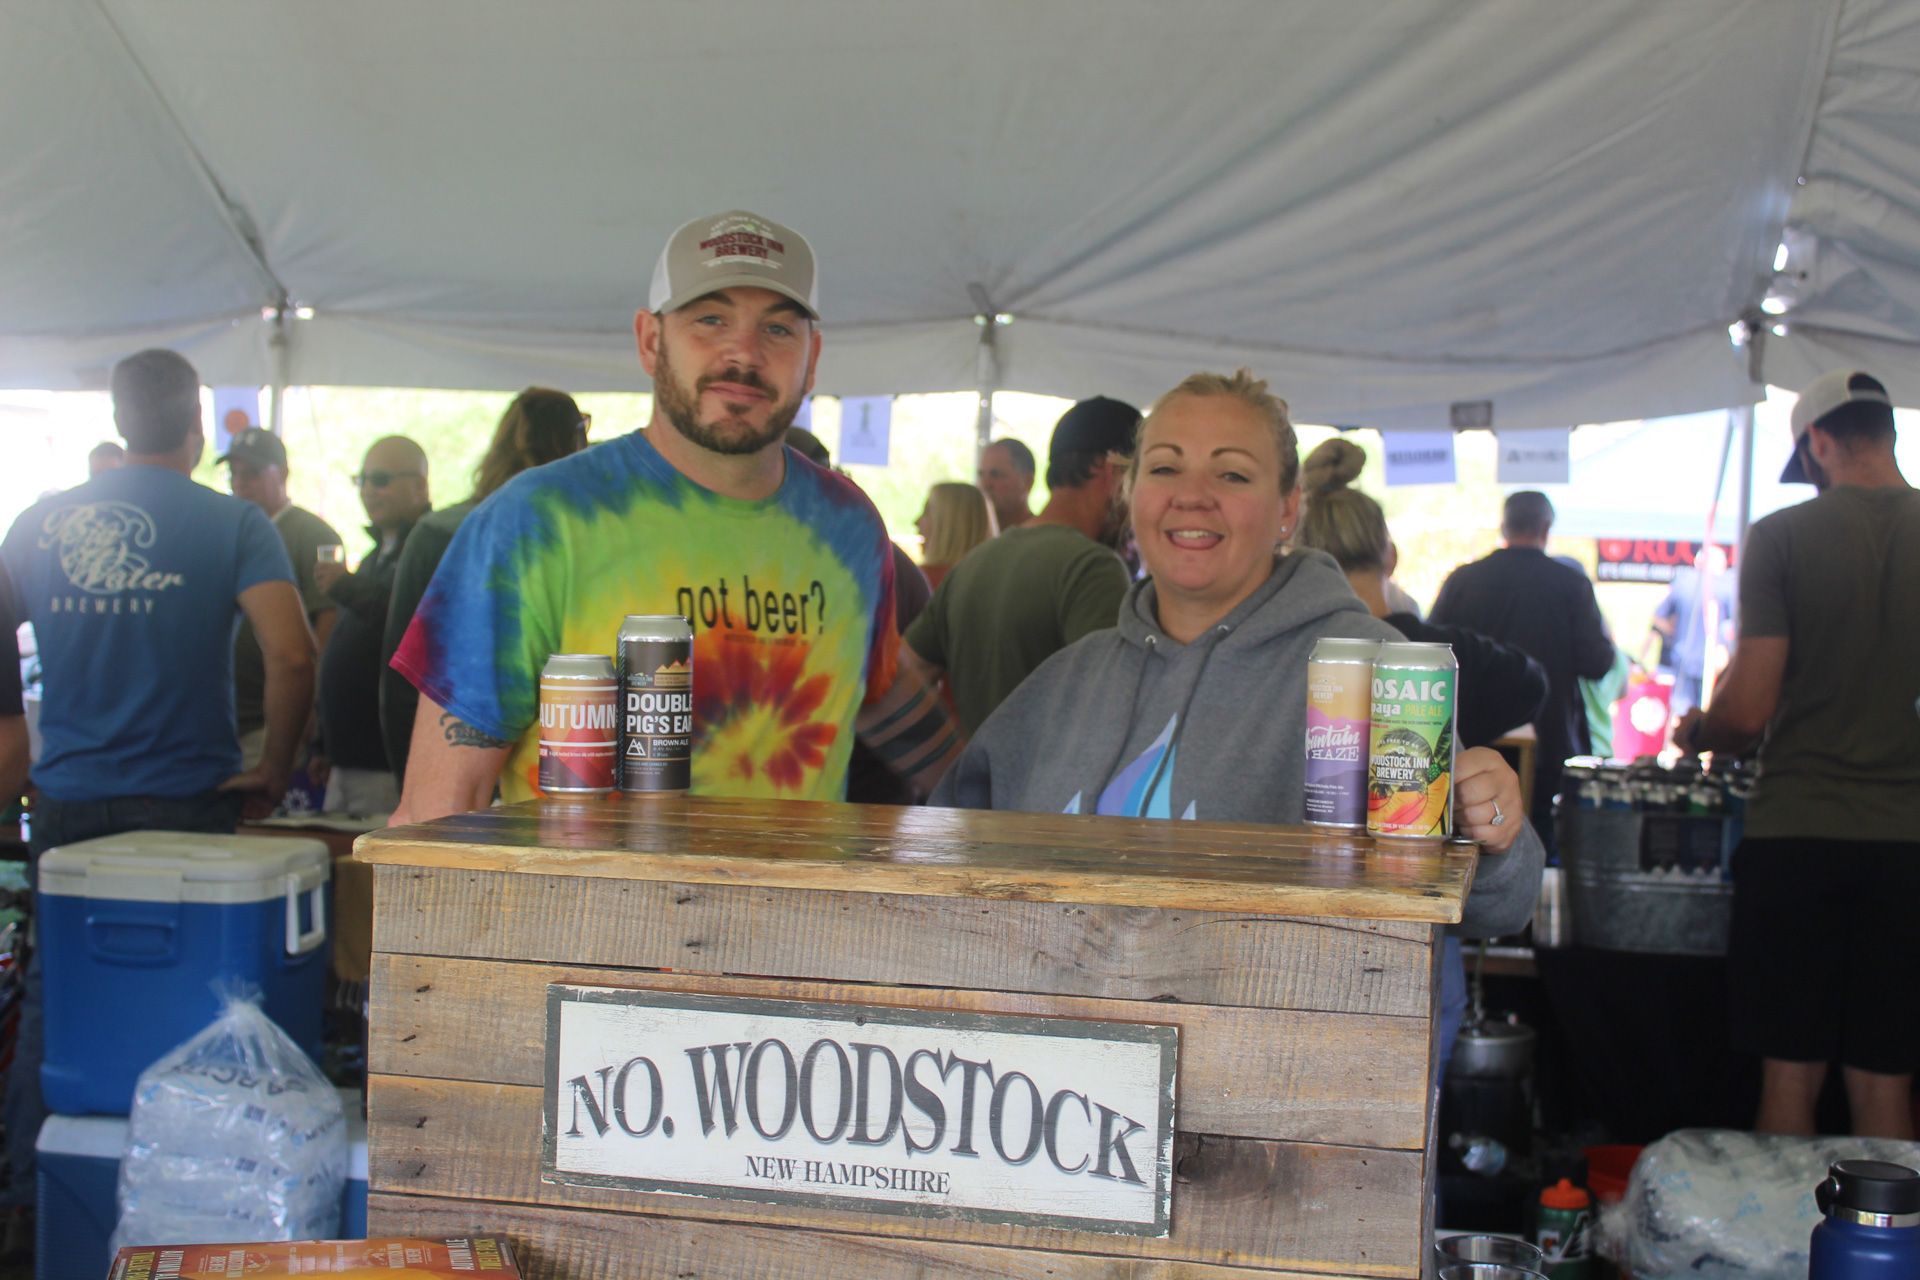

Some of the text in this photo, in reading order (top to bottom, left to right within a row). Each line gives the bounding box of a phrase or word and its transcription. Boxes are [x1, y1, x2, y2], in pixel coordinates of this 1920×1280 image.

[715, 243, 768, 259] BREWERY
[51, 596, 155, 615] BREWERY
[677, 574, 826, 637] got beer?
[1372, 678, 1447, 702] OSAIC
[539, 703, 616, 730] AUTUMN
[1429, 704, 1443, 717] ALE
[626, 714, 670, 734] PIG'S
[1311, 746, 1360, 761] HAZE
[1413, 757, 1430, 769] INN
[1376, 766, 1414, 780] BREWERY
[563, 1038, 1148, 1187] NO. WOODSTOCK
[745, 1155, 950, 1195] NEW HAMPSHIRE
